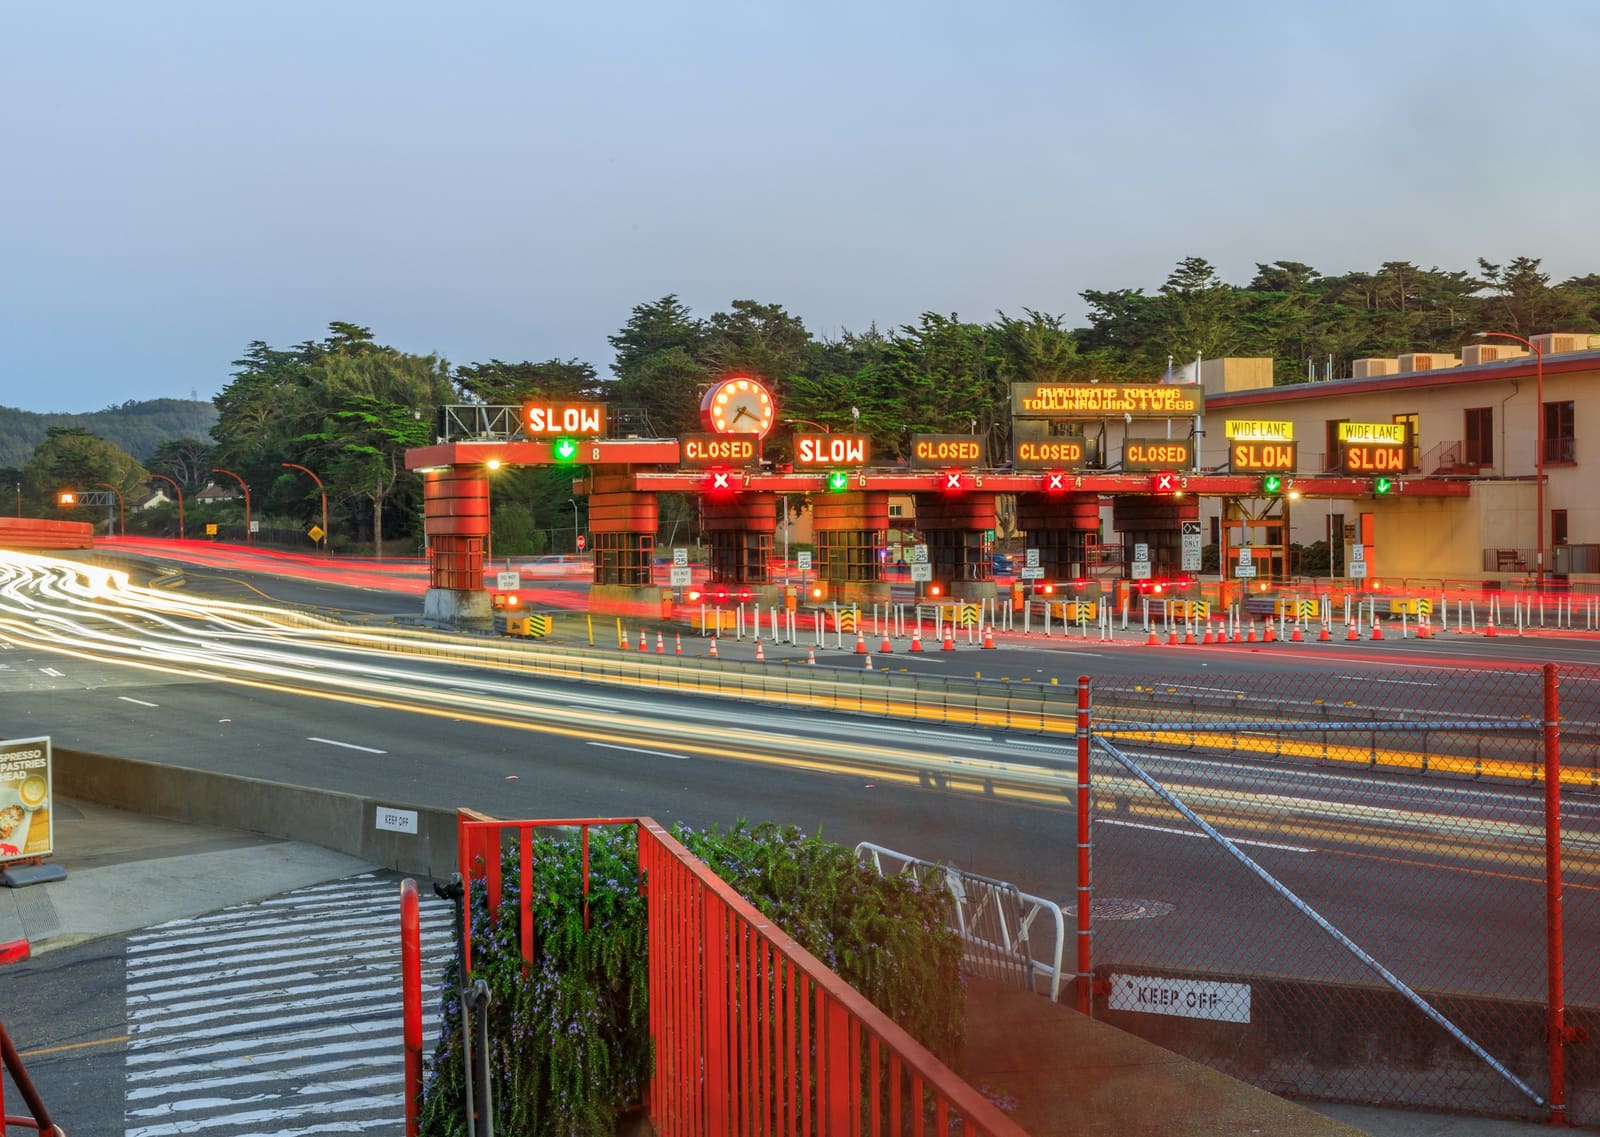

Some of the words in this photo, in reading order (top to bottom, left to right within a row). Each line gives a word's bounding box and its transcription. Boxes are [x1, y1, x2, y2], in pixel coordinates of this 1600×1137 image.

[529, 407, 600, 432] SLOW
[1231, 421, 1257, 438] WIDE
[1261, 421, 1287, 439] LANE
[1345, 424, 1370, 440] WIDE
[1373, 425, 1400, 440] LANE
[592, 447, 600, 461] 8
[686, 441, 753, 458] CLOSED
[799, 439, 864, 462] SLOW
[916, 441, 980, 460] CLOSED
[1020, 443, 1081, 461] CLOSED
[1127, 446, 1187, 463] CLOSED
[1234, 445, 1293, 467] SLOW
[1348, 447, 1404, 471] SLOW
[743, 474, 752, 487] 7
[858, 474, 867, 487] 6
[975, 475, 983, 488] 5
[1074, 475, 1082, 488] 4
[1181, 476, 1188, 489] 3
[1287, 479, 1294, 491] 2
[1398, 481, 1404, 492] 1
[675, 557, 687, 566] 25
[916, 553, 927, 562] 25
[1028, 557, 1038, 566] 25
[1136, 552, 1147, 560] 25
[1241, 557, 1251, 565] 25
[799, 560, 810, 568] 25
[0, 758, 47, 772] PASTRIES
[384, 814, 398, 825] KEEP
[399, 816, 409, 827] OFF
[1138, 986, 1179, 1006] KEEP
[1186, 991, 1218, 1009] OFF
